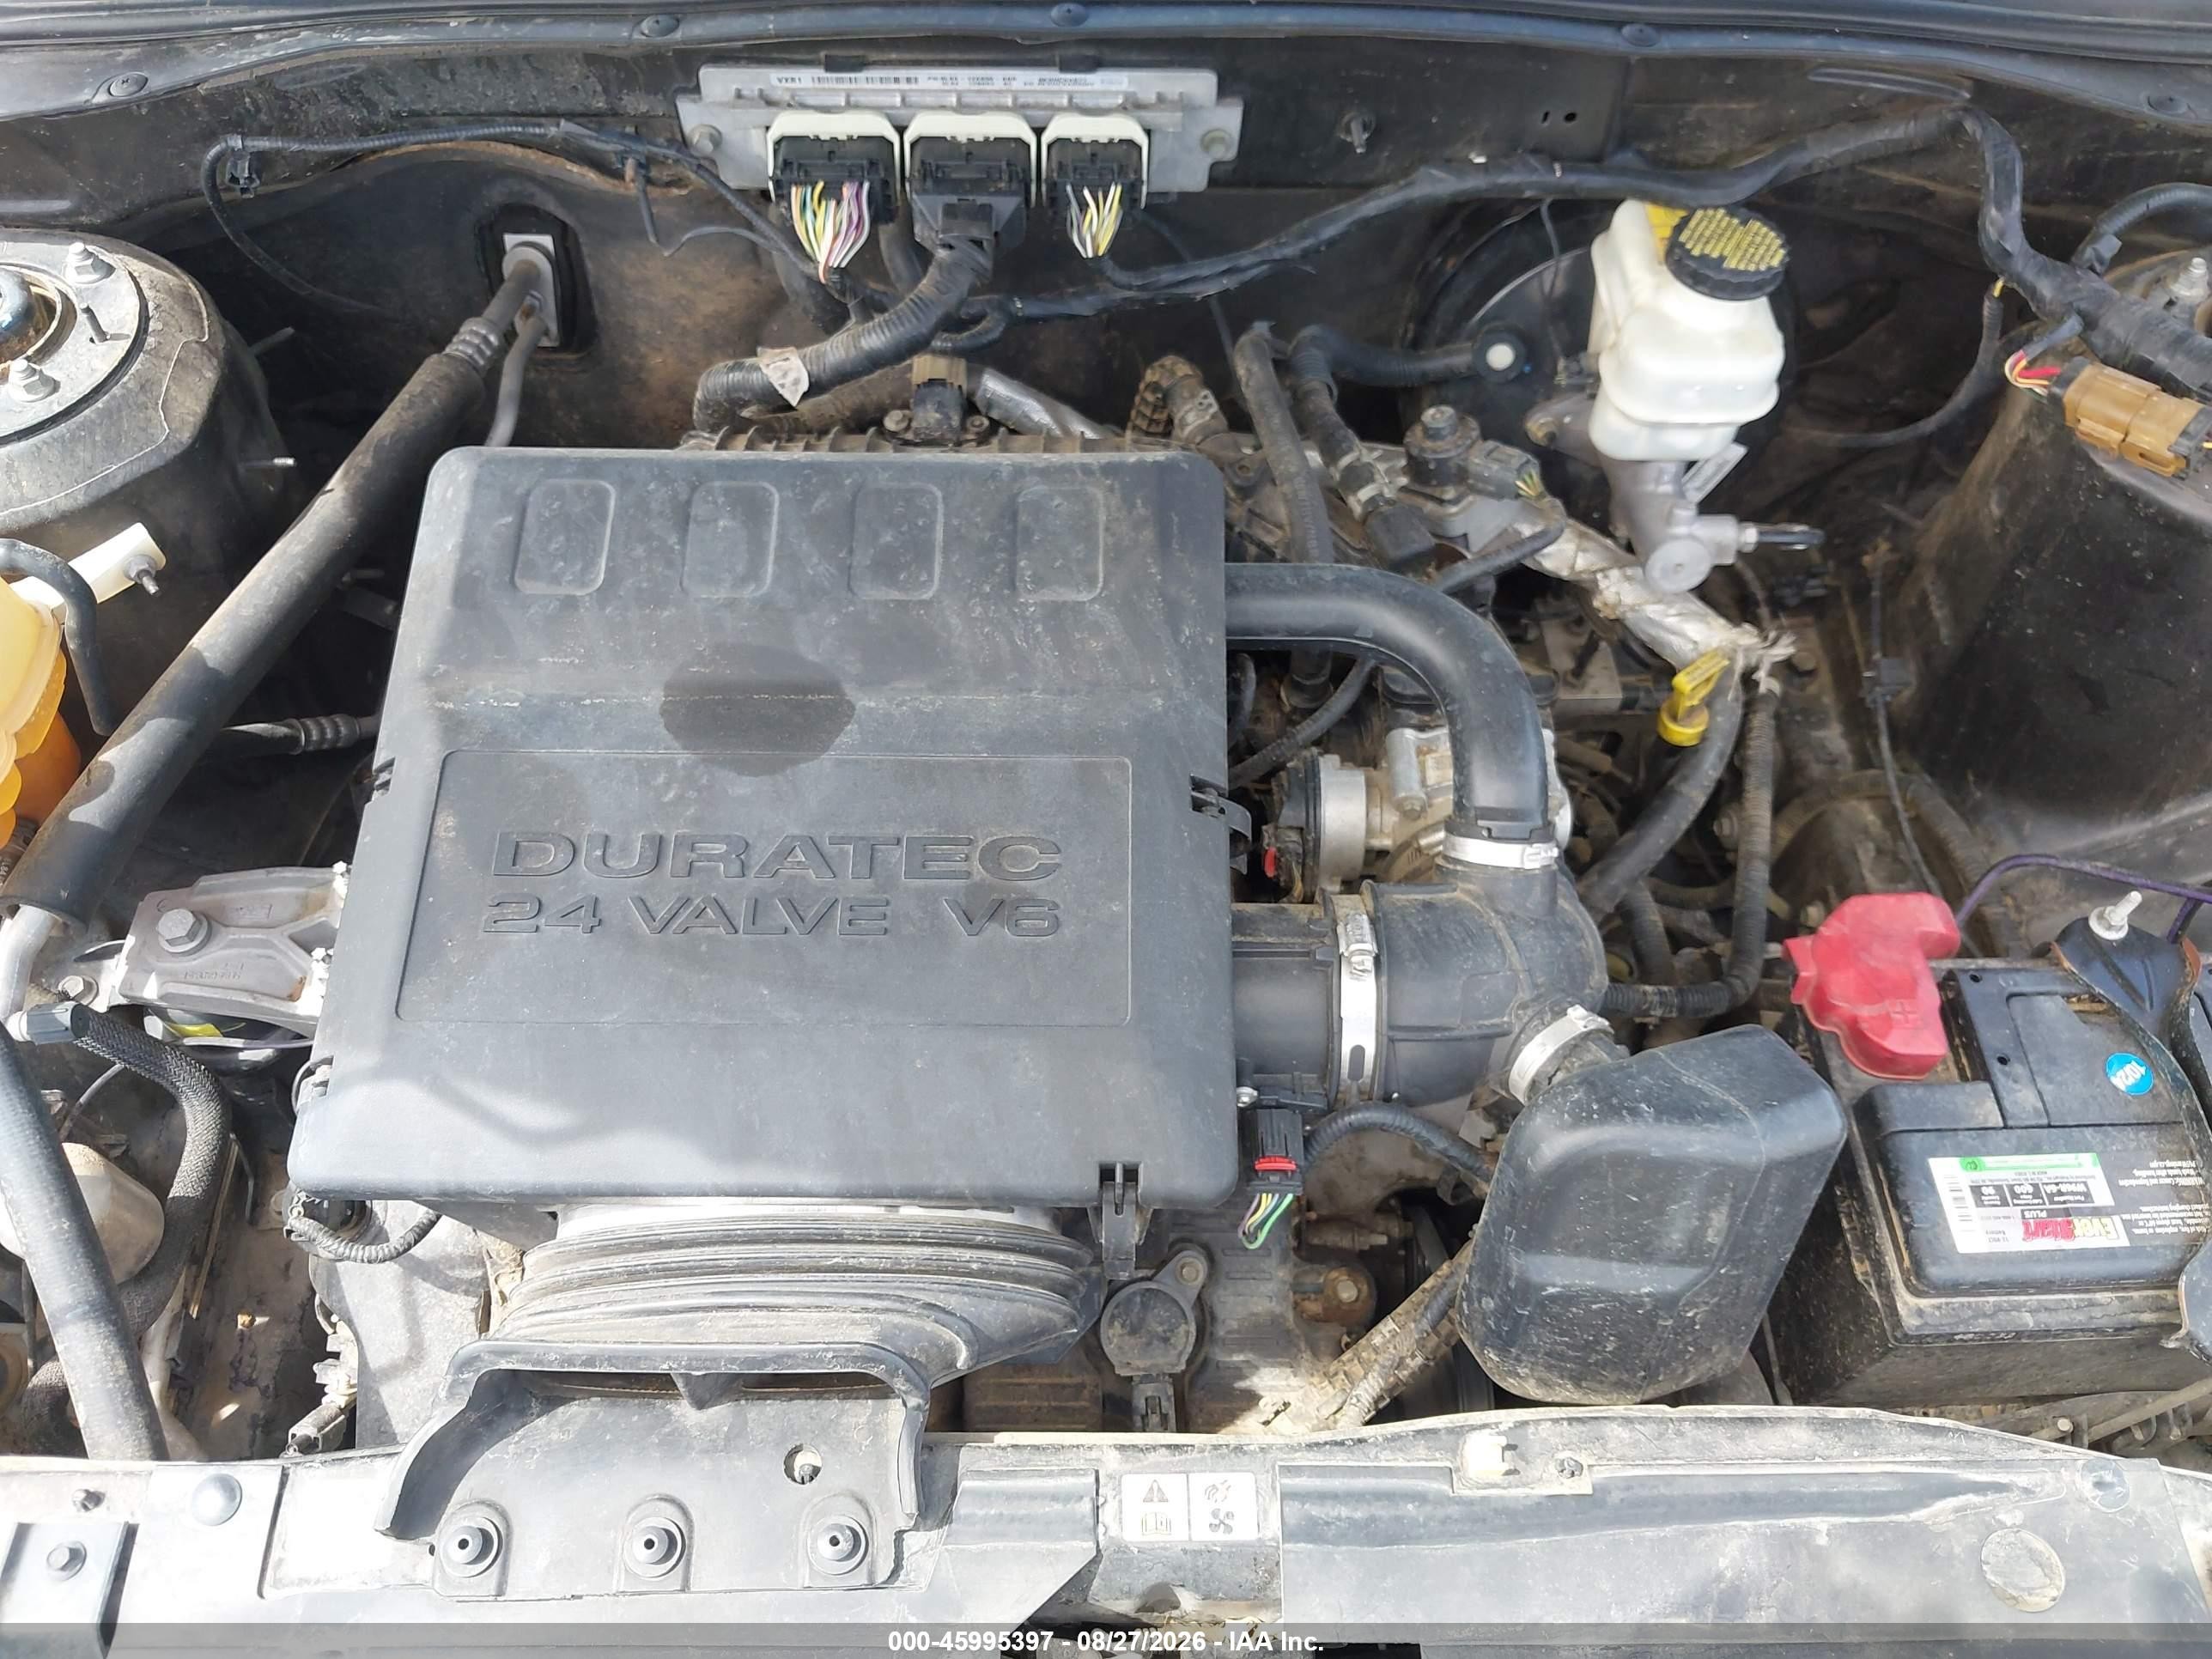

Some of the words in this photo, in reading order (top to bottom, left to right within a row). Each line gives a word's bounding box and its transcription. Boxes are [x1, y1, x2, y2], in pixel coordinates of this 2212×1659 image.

[492, 831, 1062, 881] DURATEC
[483, 893, 602, 934] 24
[628, 895, 890, 936] VALVE
[944, 896, 1060, 937] V6
[2022, 1217, 2118, 1242] EverStart
